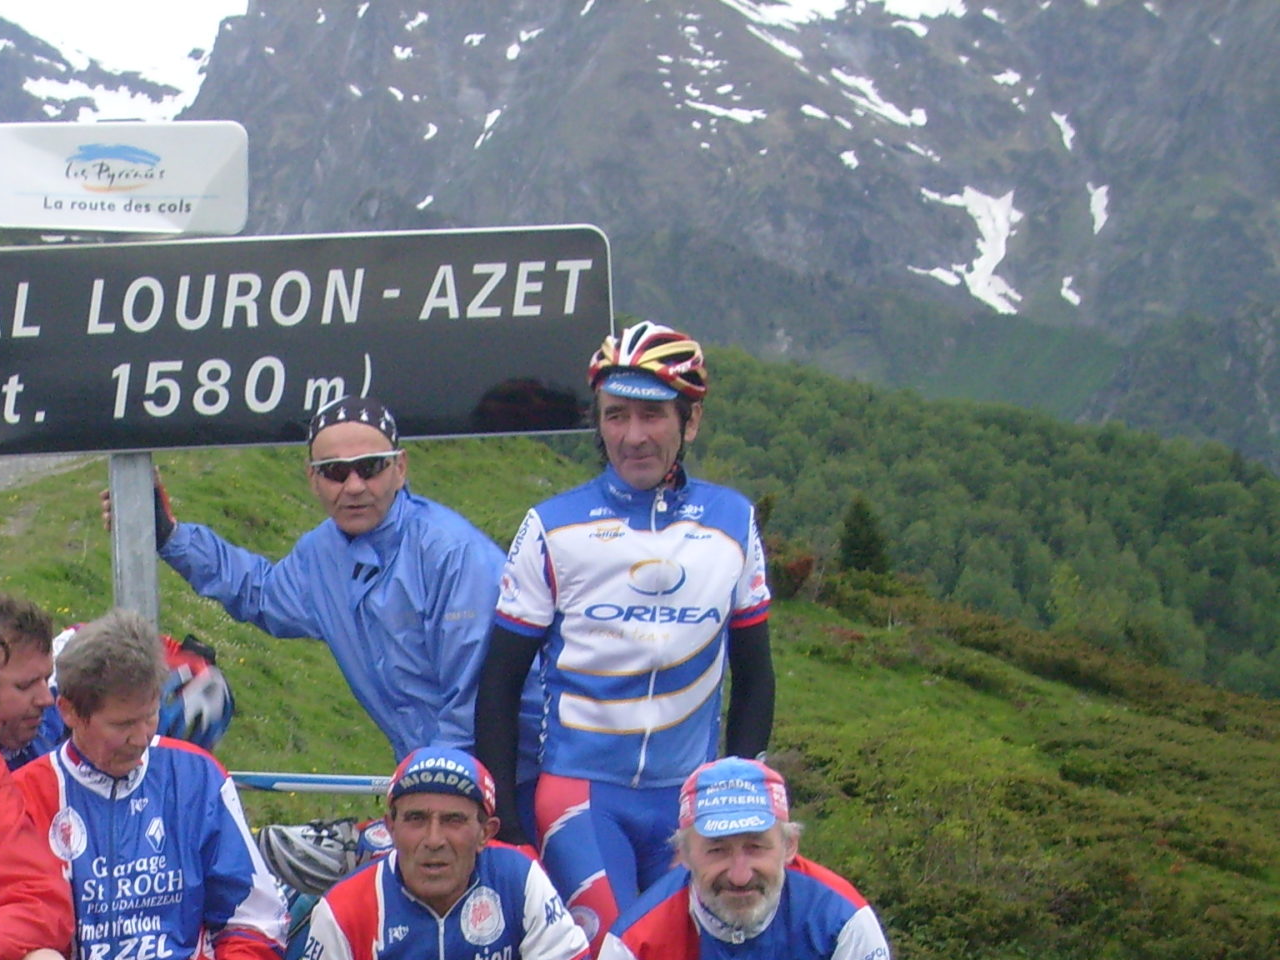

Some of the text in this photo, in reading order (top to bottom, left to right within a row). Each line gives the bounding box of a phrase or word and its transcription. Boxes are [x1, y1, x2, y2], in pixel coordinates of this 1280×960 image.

[43, 196, 192, 214] La route des cols
[86, 267, 365, 335] LOURON
[419, 258, 593, 321] AZET
[110, 355, 286, 419] 1580
[585, 603, 721, 625] ORBEA
[400, 771, 476, 794] MIGADEL
[704, 816, 765, 832] MIGADEL
[92, 855, 167, 878] Garage
[81, 869, 184, 902] St ROCH
[77, 911, 161, 942] imentation
